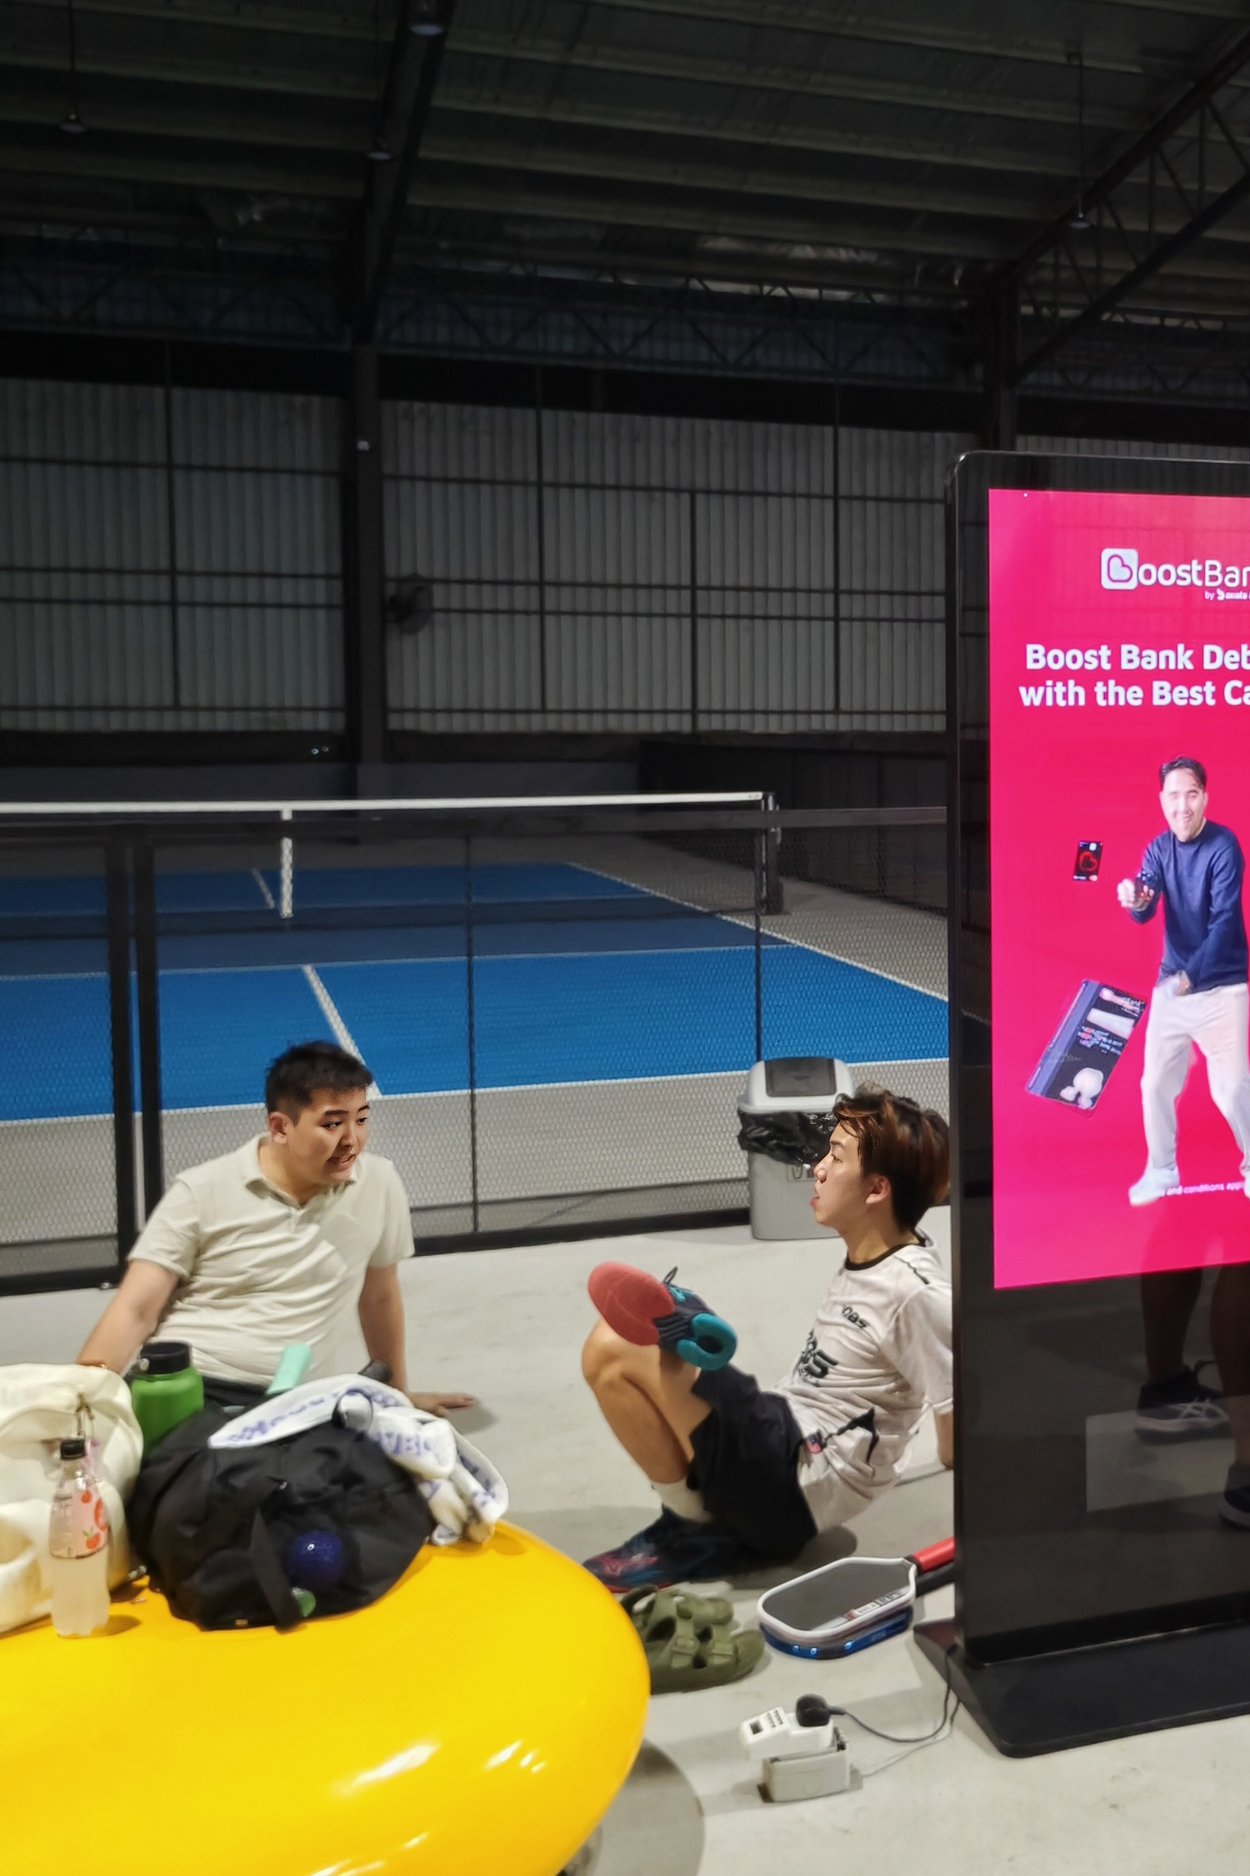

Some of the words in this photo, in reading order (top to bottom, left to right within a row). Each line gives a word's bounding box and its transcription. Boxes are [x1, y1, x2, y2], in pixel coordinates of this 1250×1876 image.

[1026, 644, 1112, 671] Boost
[1120, 643, 1194, 670] Bank
[1018, 679, 1086, 707] with
[1094, 679, 1144, 707] the
[1152, 680, 1216, 706] Best
